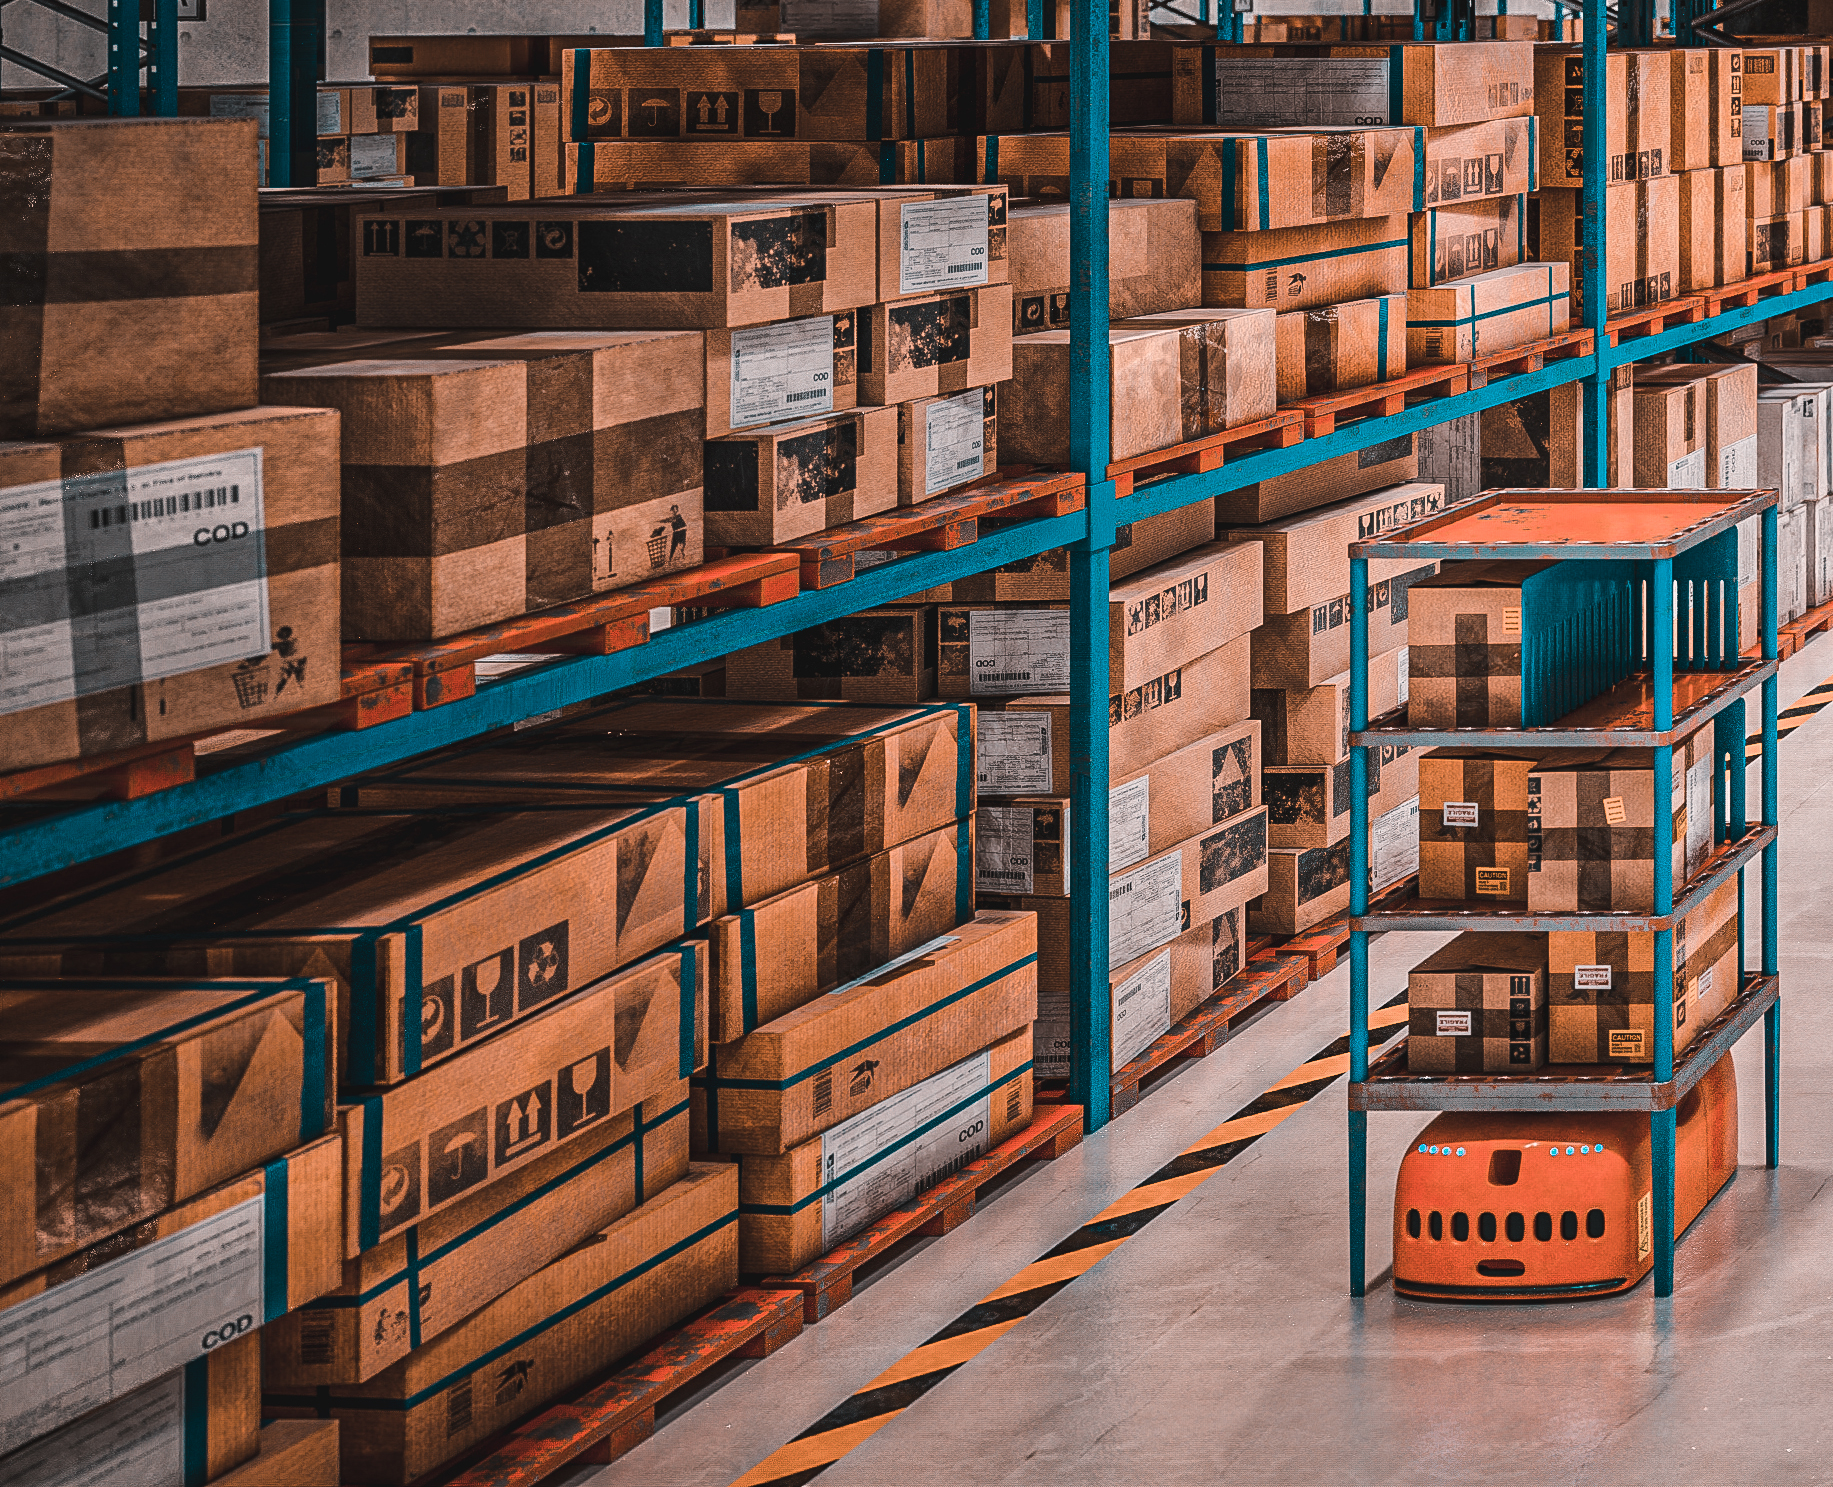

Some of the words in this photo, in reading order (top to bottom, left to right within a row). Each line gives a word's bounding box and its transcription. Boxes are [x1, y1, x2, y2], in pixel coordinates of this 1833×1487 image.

[1355, 116, 1383, 126] COD
[971, 247, 984, 255] COD
[813, 372, 828, 381] COD
[193, 521, 248, 546] COD
[1010, 857, 1028, 866] COD
[959, 1120, 983, 1142] COD
[202, 1314, 253, 1349] COD
